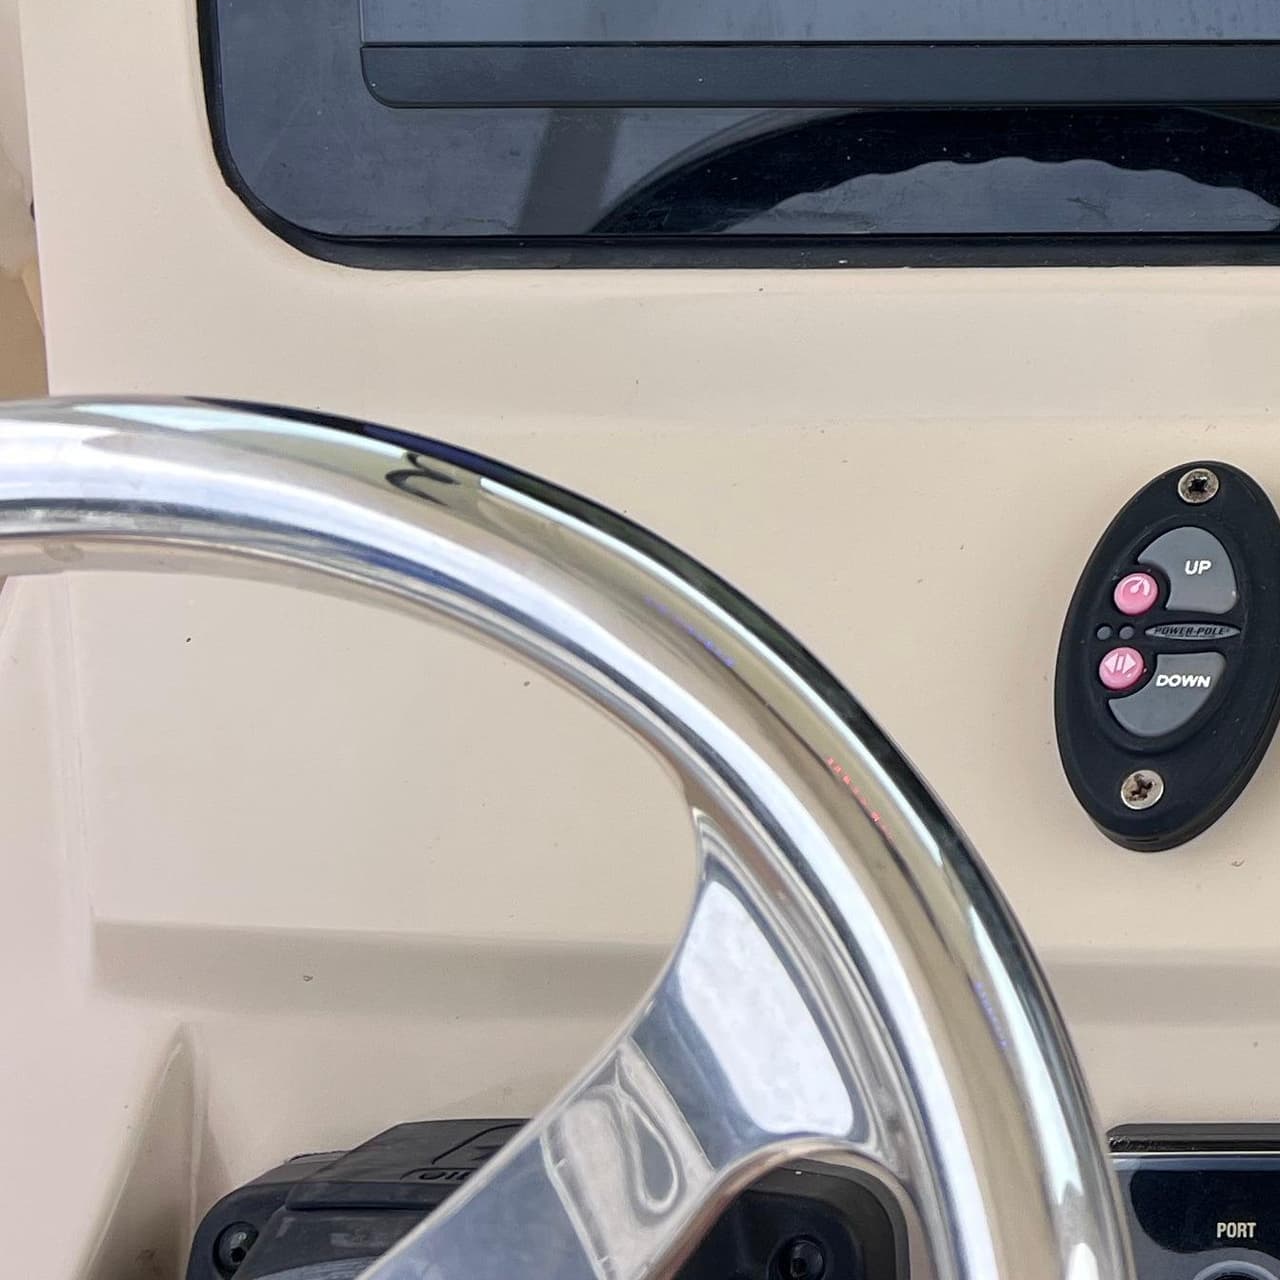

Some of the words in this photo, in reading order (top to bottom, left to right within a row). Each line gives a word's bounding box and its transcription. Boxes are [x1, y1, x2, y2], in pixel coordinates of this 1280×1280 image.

[1184, 559, 1212, 576] UP
[1156, 673, 1210, 688] DOWN
[1216, 1222, 1256, 1239] PORT
